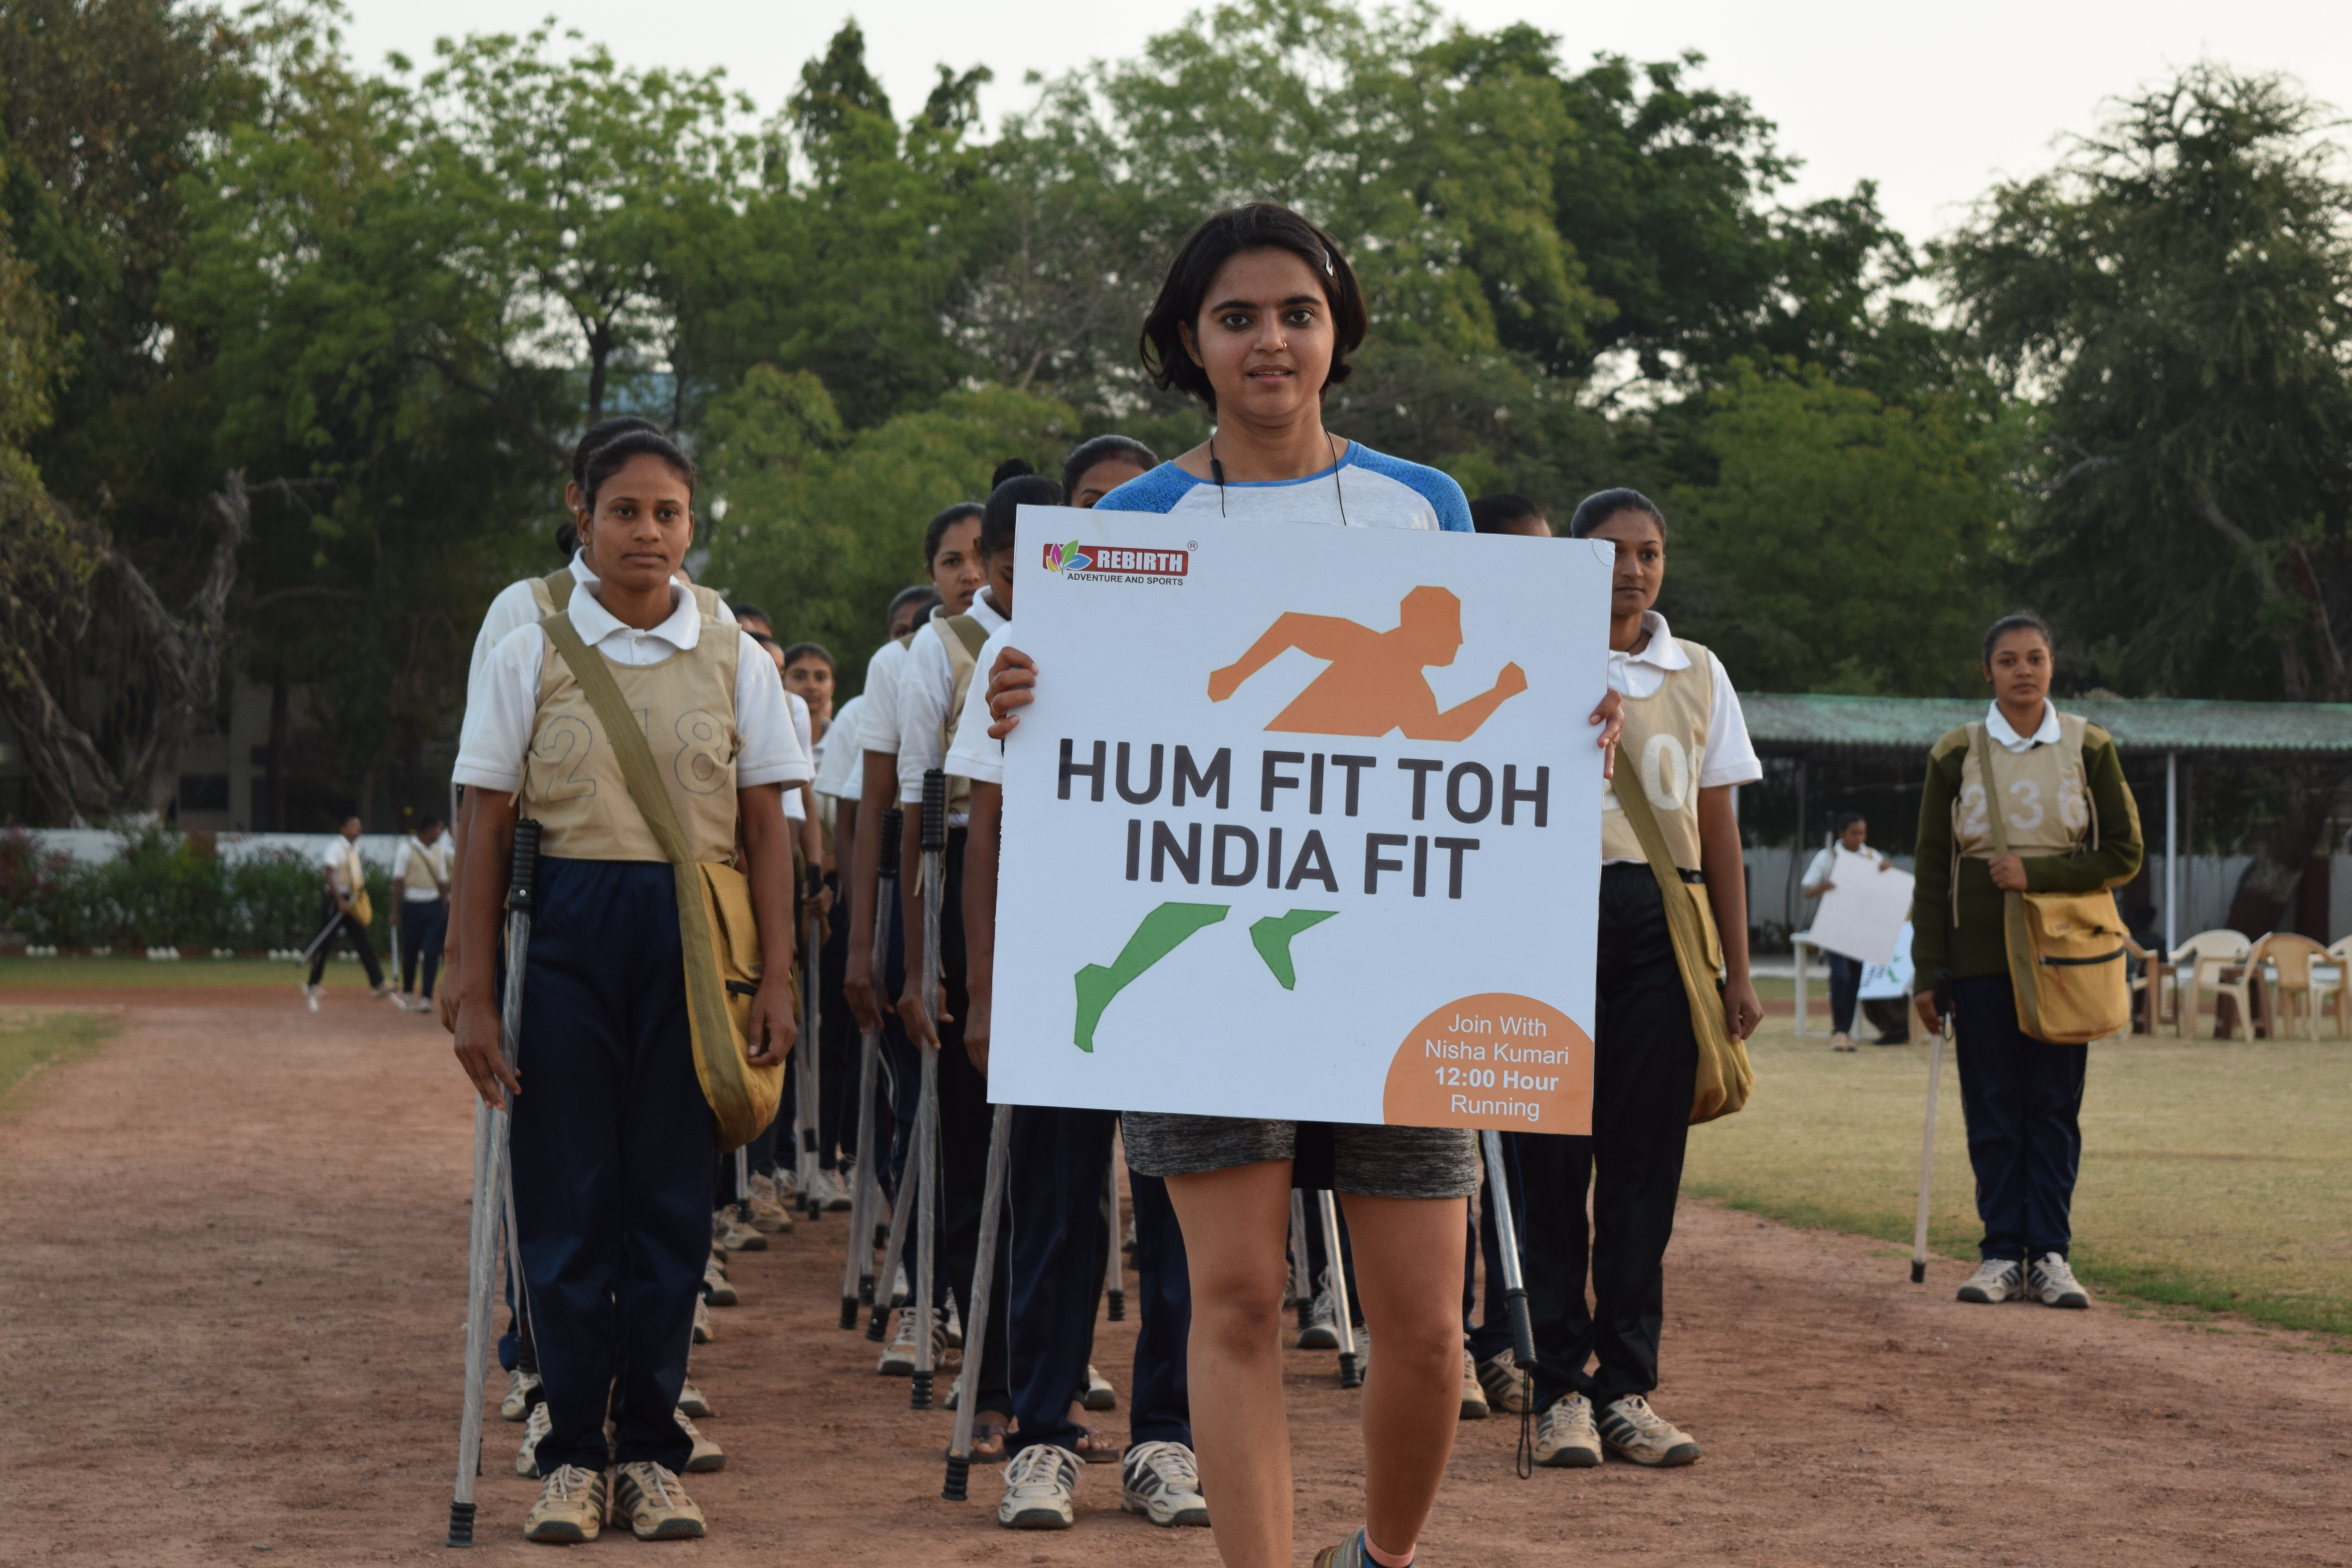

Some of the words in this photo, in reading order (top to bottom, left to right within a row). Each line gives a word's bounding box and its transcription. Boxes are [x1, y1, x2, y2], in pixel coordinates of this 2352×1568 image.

[1097, 550, 1183, 572] REBIRTH
[1067, 573, 1123, 583] ADVENTURE
[1125, 576, 1144, 584] AND
[1147, 577, 1183, 586] SPORTS
[1057, 738, 1231, 809] HUM
[1260, 750, 1377, 817] FIT
[1397, 758, 1550, 828] TOH
[1962, 779, 2089, 836] 236
[1125, 819, 1339, 893] INDIA
[1364, 832, 1480, 899] FIT
[1448, 1013, 1492, 1034] Join
[1499, 1016, 1546, 1037] With
[1425, 1039, 1486, 1061] Nisha
[1493, 1042, 1569, 1065] Kumari
[1435, 1066, 1495, 1088] 12:00
[1503, 1070, 1559, 1091] Hour
[1451, 1094, 1539, 1122] Running
